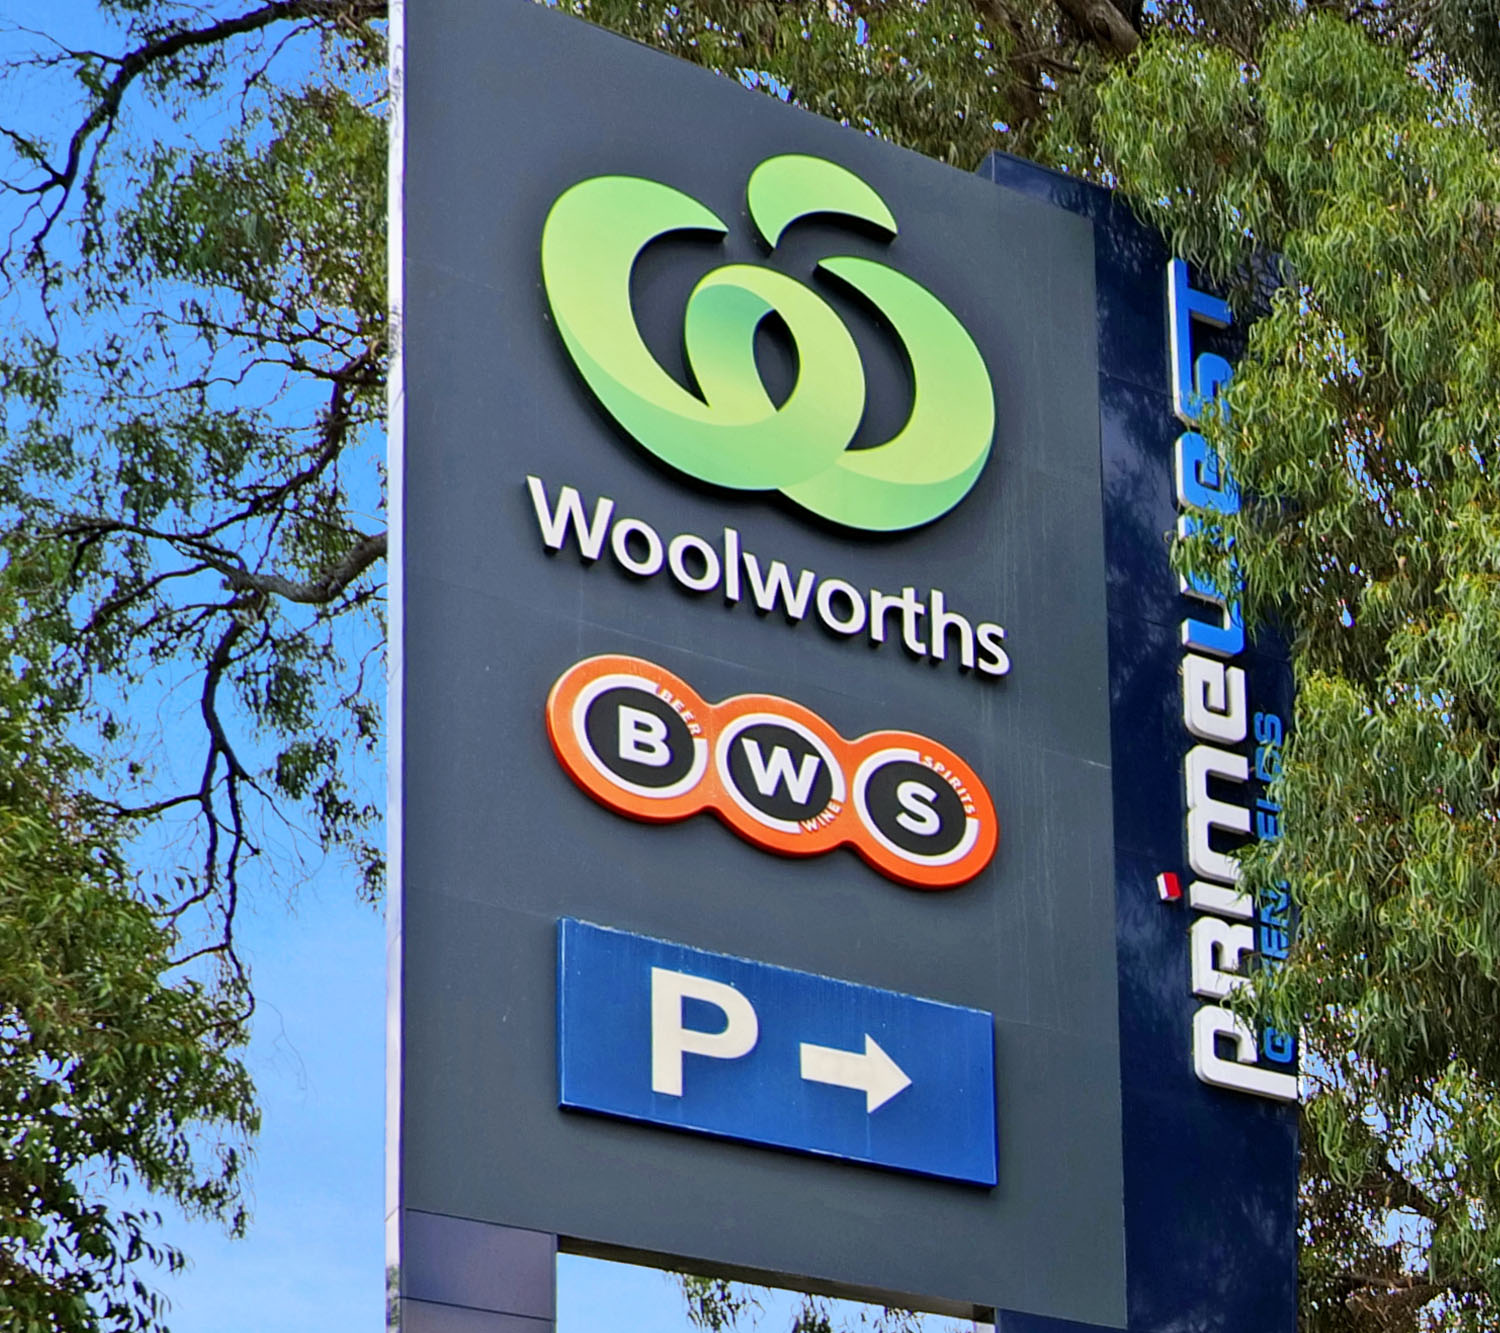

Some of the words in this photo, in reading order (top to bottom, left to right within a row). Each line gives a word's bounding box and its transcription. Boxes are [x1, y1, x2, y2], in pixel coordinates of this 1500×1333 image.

[526, 474, 1011, 676] Woolworths
[656, 685, 702, 738] BEER
[802, 798, 842, 834] WINE
[921, 754, 977, 816] SPIRITS
[651, 967, 758, 1097] P
